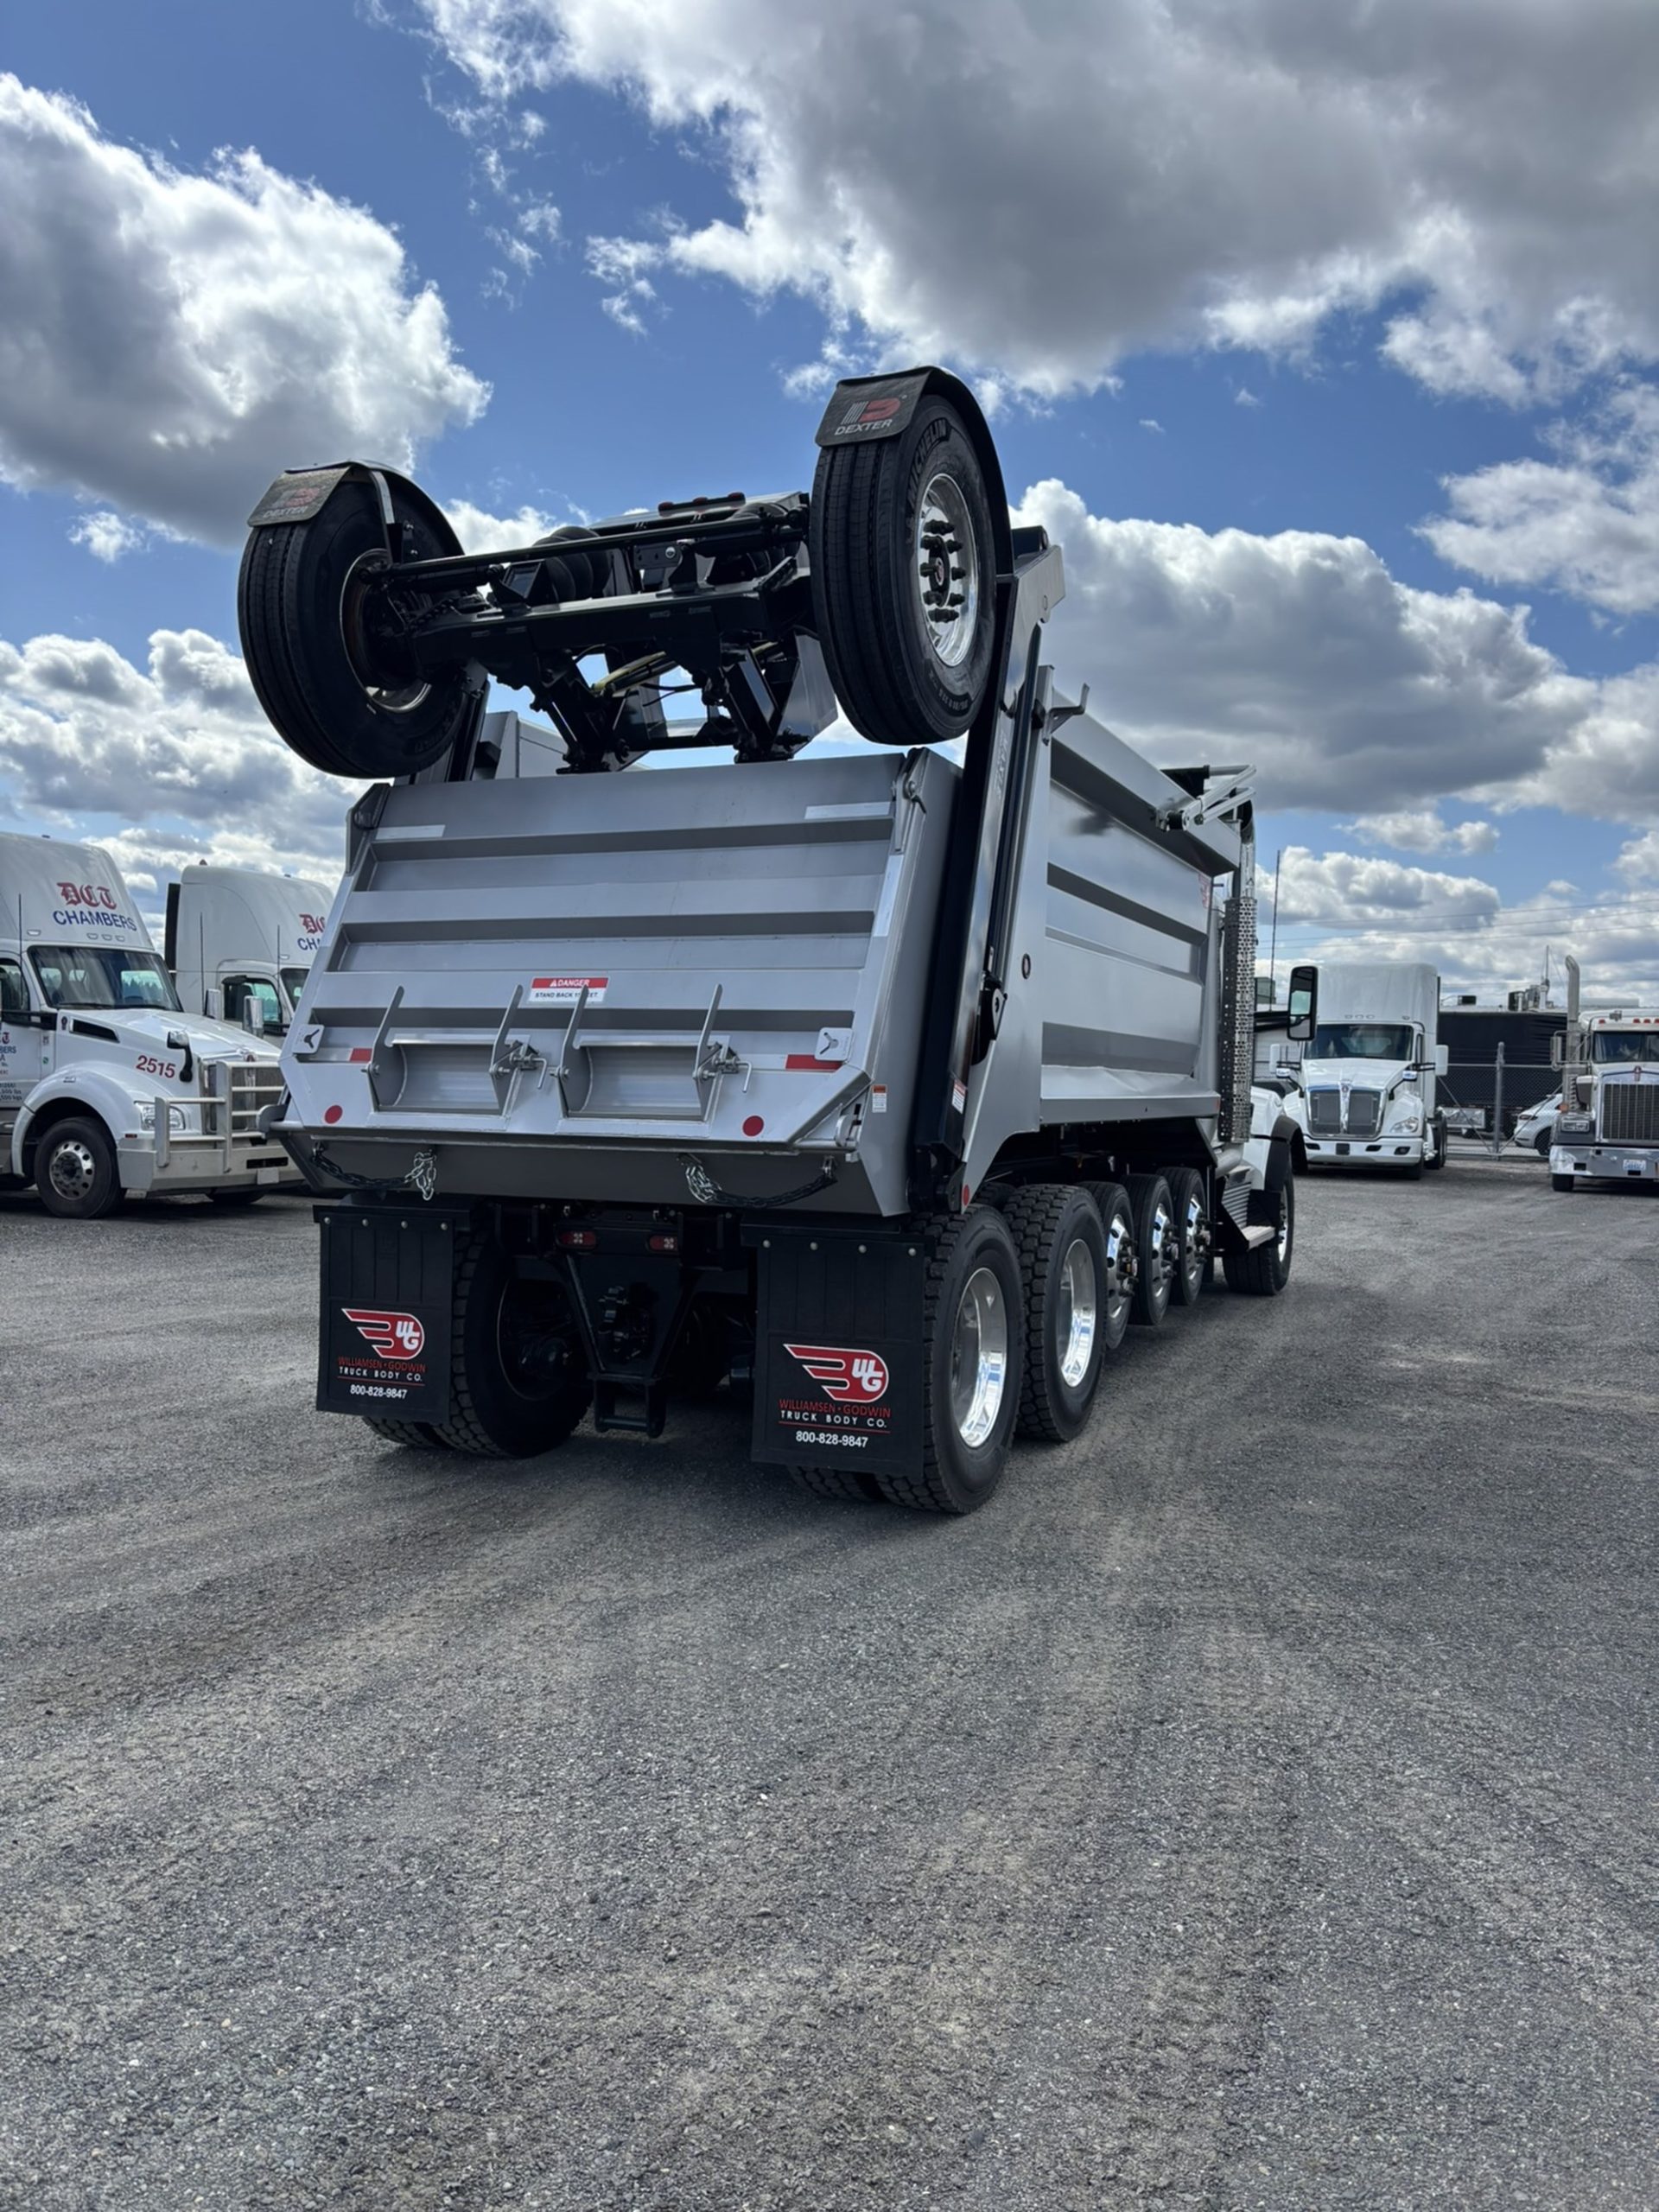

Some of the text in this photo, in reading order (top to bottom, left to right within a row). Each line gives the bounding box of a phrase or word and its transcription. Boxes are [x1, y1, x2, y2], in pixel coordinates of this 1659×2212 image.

[834, 419, 893, 435] DEXTER
[56, 882, 118, 910] DCT
[53, 910, 137, 931] CHAMBERS
[557, 978, 590, 987] DANGER
[136, 1054, 176, 1078] 2515
[338, 1357, 426, 1373] WILLIAMSEN GODWIN
[339, 1366, 423, 1382] TRUCK BODY CO.
[350, 1384, 408, 1399] 800-828-9847
[779, 1399, 891, 1418] WILLIAMSEN GODWIN
[780, 1410, 887, 1428] TRUCK BODY CO.
[796, 1430, 868, 1448] 800-828-9847
